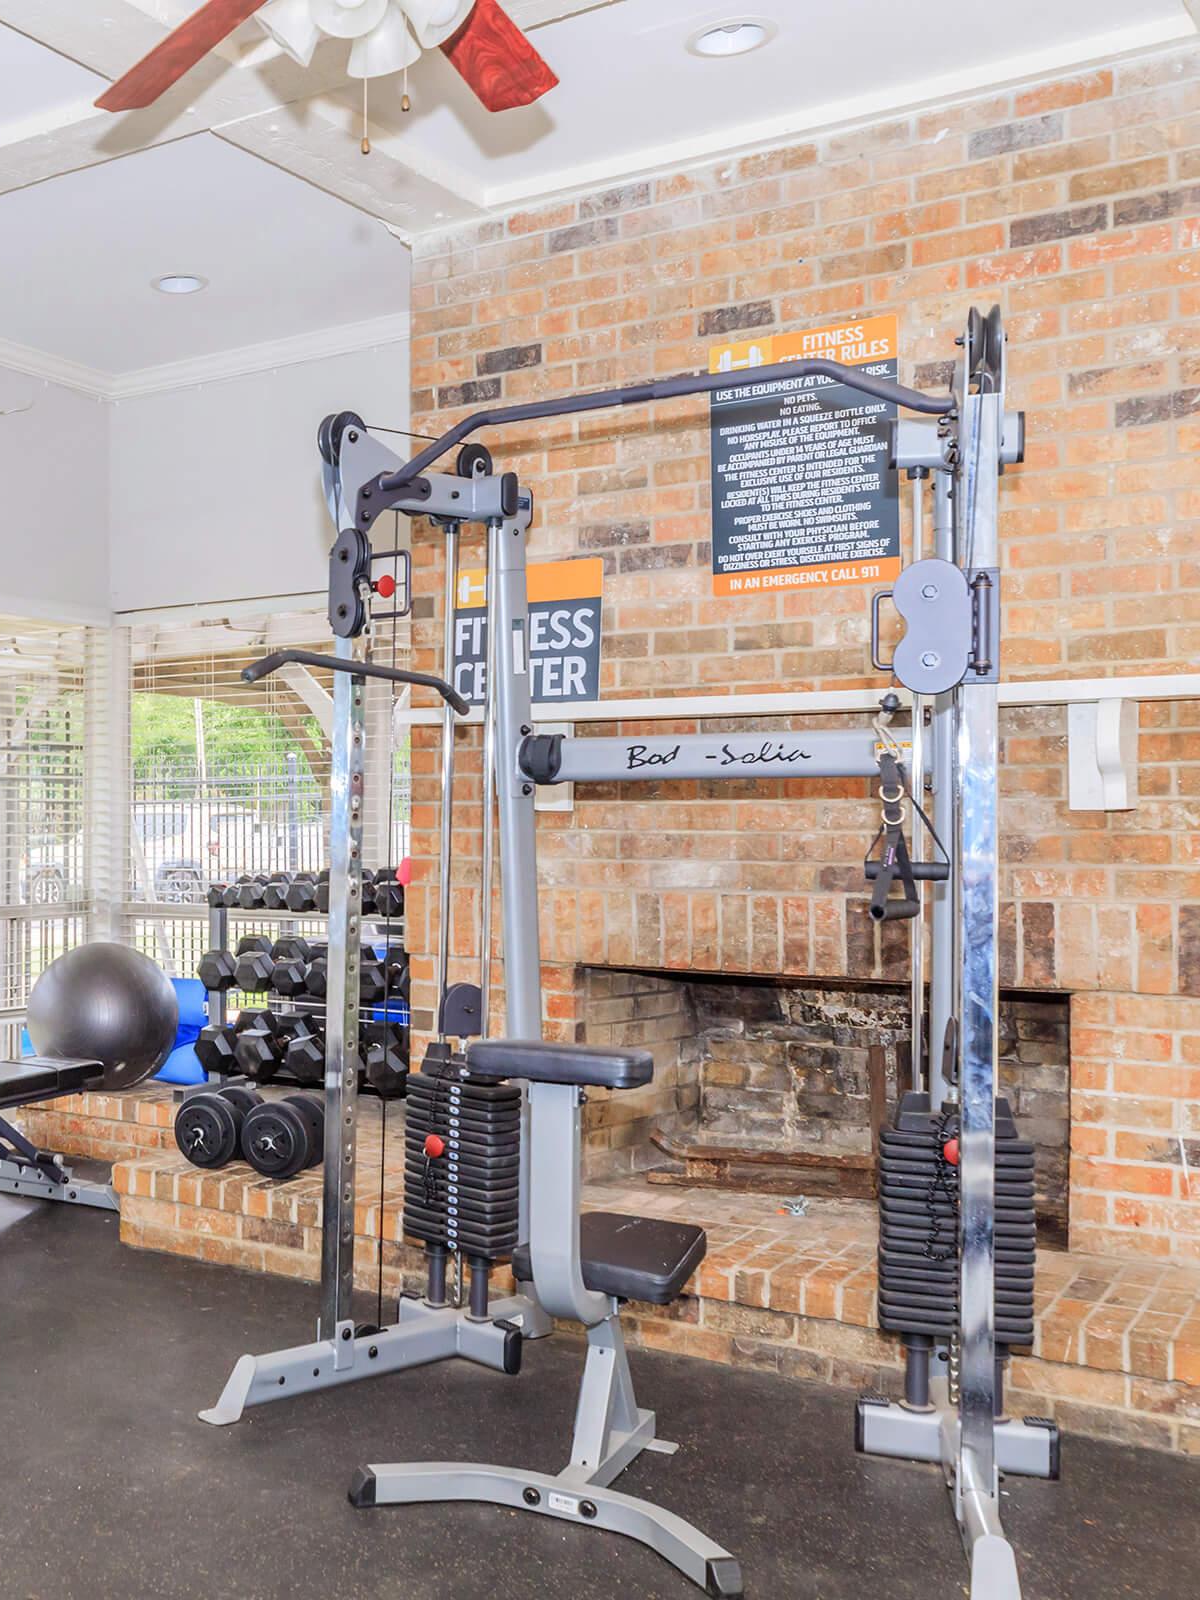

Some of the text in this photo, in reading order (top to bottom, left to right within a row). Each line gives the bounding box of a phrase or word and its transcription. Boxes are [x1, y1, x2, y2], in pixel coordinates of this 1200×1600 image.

[802, 324, 863, 351] FITNESS
[841, 338, 888, 361] RULES
[716, 389, 732, 402] USE
[733, 386, 750, 399] THE
[751, 377, 802, 396] EQUIPMENT
[803, 375, 815, 387] AT
[783, 395, 794, 405] NO
[719, 423, 755, 436] DRINKING
[756, 419, 781, 431] WATER
[782, 417, 791, 427] IN
[791, 416, 799, 425] A
[799, 410, 832, 424] SQUEEZE
[833, 405, 864, 418] BOTTLE
[779, 407, 790, 416] NO
[727, 436, 737, 445] NO
[781, 425, 808, 437] PLEASE
[809, 420, 838, 433] REPORT
[840, 419, 850, 428] TO
[851, 414, 876, 426] OFFICE
[729, 450, 769, 463] OCCUPANTS
[770, 446, 795, 457] UNDER
[803, 441, 825, 452] YEARS
[827, 440, 837, 449] OF
[837, 438, 851, 447] AGE
[852, 434, 875, 445] MUST
[743, 441, 758, 451] ANY
[760, 437, 787, 448] MISUSE
[788, 435, 799, 444] OF
[799, 433, 814, 443] THE
[717, 441, 888, 473] BE ACCOMPANIED BY PARENT OR LEGAL GUARDIAN
[724, 453, 875, 482] THE FITNESS CENTER IS INTENDED FOR THE
[740, 476, 777, 488] EXCLUSIVE
[778, 474, 792, 483] USE
[793, 472, 803, 481] OF
[805, 470, 821, 480] OUR
[770, 484, 786, 494] WILL
[788, 482, 806, 492] KEEP
[807, 480, 820, 489] THE
[821, 476, 850, 488] FITNESS
[851, 472, 878, 484] CENTER
[721, 498, 746, 508] LOCKED
[747, 496, 756, 505] AT
[756, 495, 769, 504] ALL
[770, 492, 791, 502] TIMES
[792, 489, 819, 499] DURING
[861, 481, 880, 491] VISIT
[760, 503, 770, 512] TO
[771, 502, 784, 510] THE
[785, 498, 813, 509] FITNESS
[734, 501, 870, 525] PROPER EXERCISE SHOES AND CLOTHING
[747, 522, 768, 531] MUST
[769, 521, 778, 529] BE
[803, 517, 814, 525] NO
[729, 520, 879, 543] CONSULT WITH YOUR PHYSICIAN BEFORE
[736, 540, 774, 551] STARTING
[774, 538, 790, 547] ANY
[792, 534, 827, 545] EXERCISE
[718, 538, 890, 563] DO NOT OVER EXERT YOURSELF AT FIRST SIGNS OF
[723, 559, 759, 571] DIZZINESS
[759, 558, 770, 567] OR
[799, 551, 849, 564] DISCONTINUE
[730, 577, 741, 589] IN
[744, 576, 759, 588] AN
[831, 567, 858, 581] CALL
[862, 565, 879, 578] 911
[455, 608, 594, 656] FIESS
[455, 656, 587, 700] CETER
